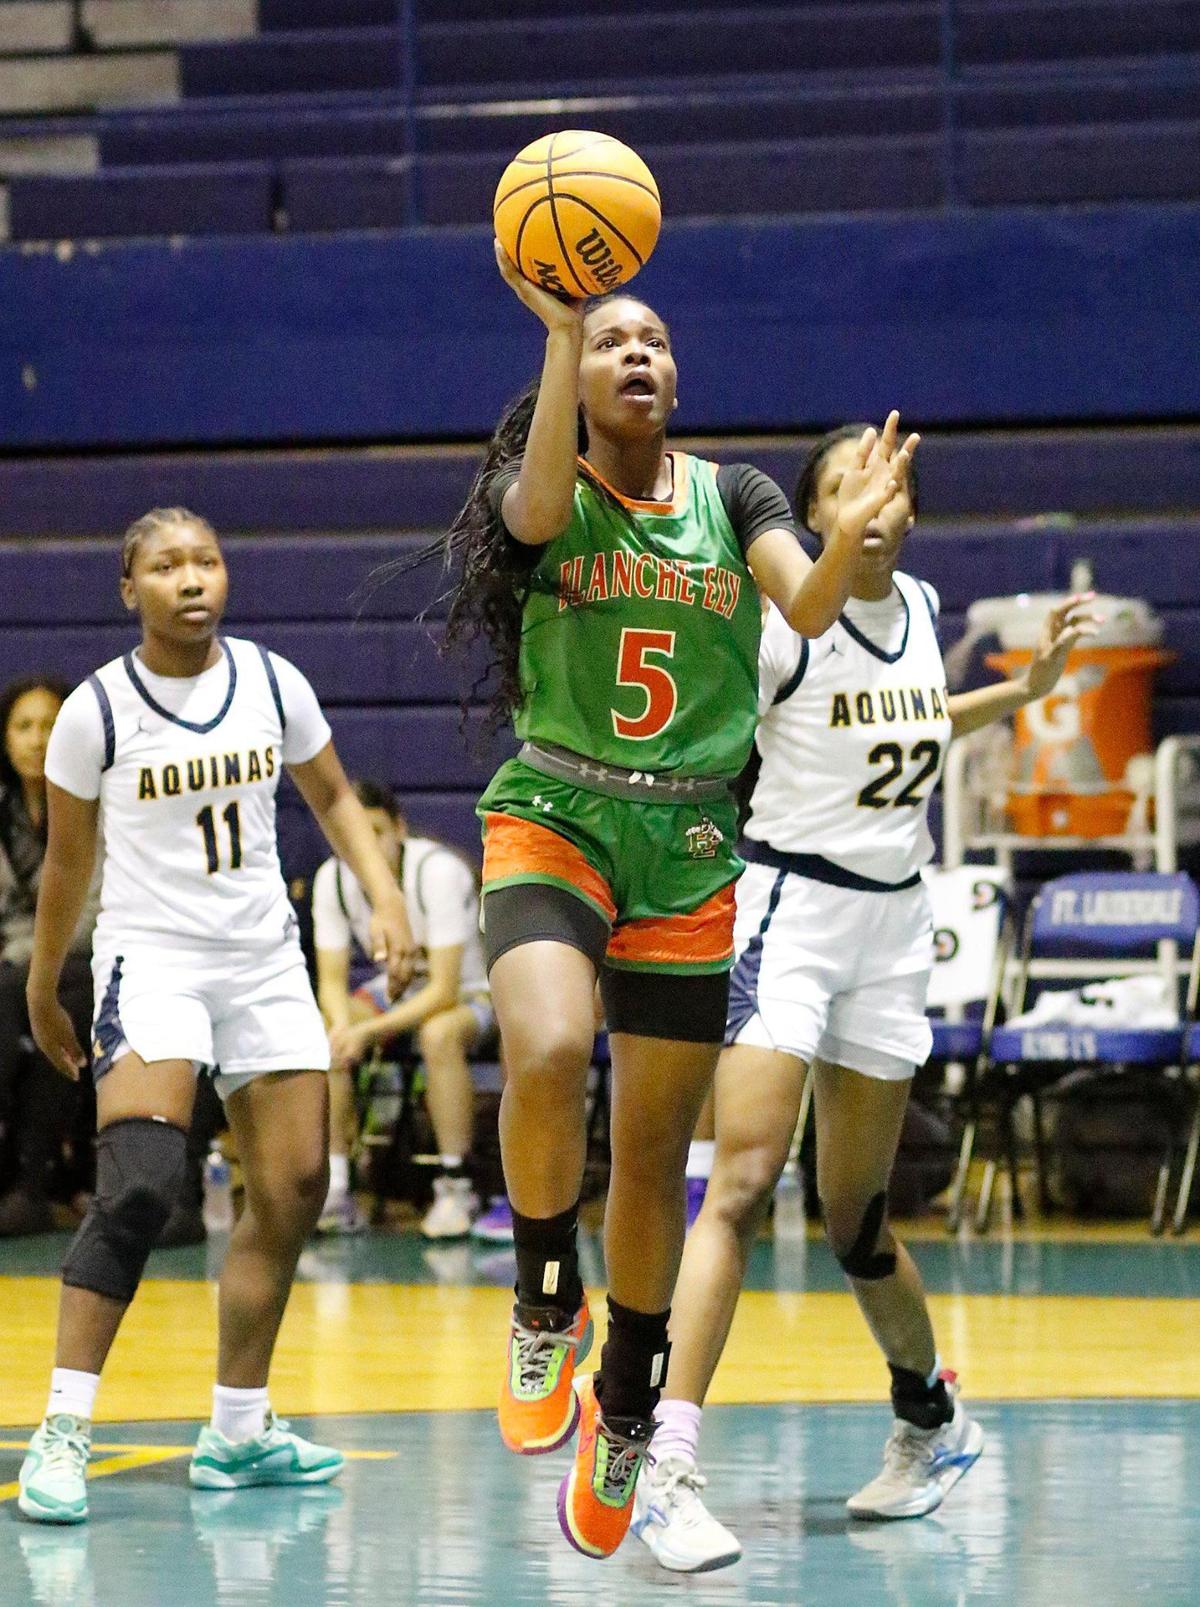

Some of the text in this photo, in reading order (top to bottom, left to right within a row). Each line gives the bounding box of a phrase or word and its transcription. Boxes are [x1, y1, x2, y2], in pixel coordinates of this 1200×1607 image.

[575, 227, 623, 291] Wils
[702, 565, 741, 620] ELY
[610, 627, 678, 741] 5
[829, 687, 946, 728] AQUINA
[137, 745, 275, 801] AQUINAS
[856, 738, 941, 809] 22
[196, 800, 241, 874] 11
